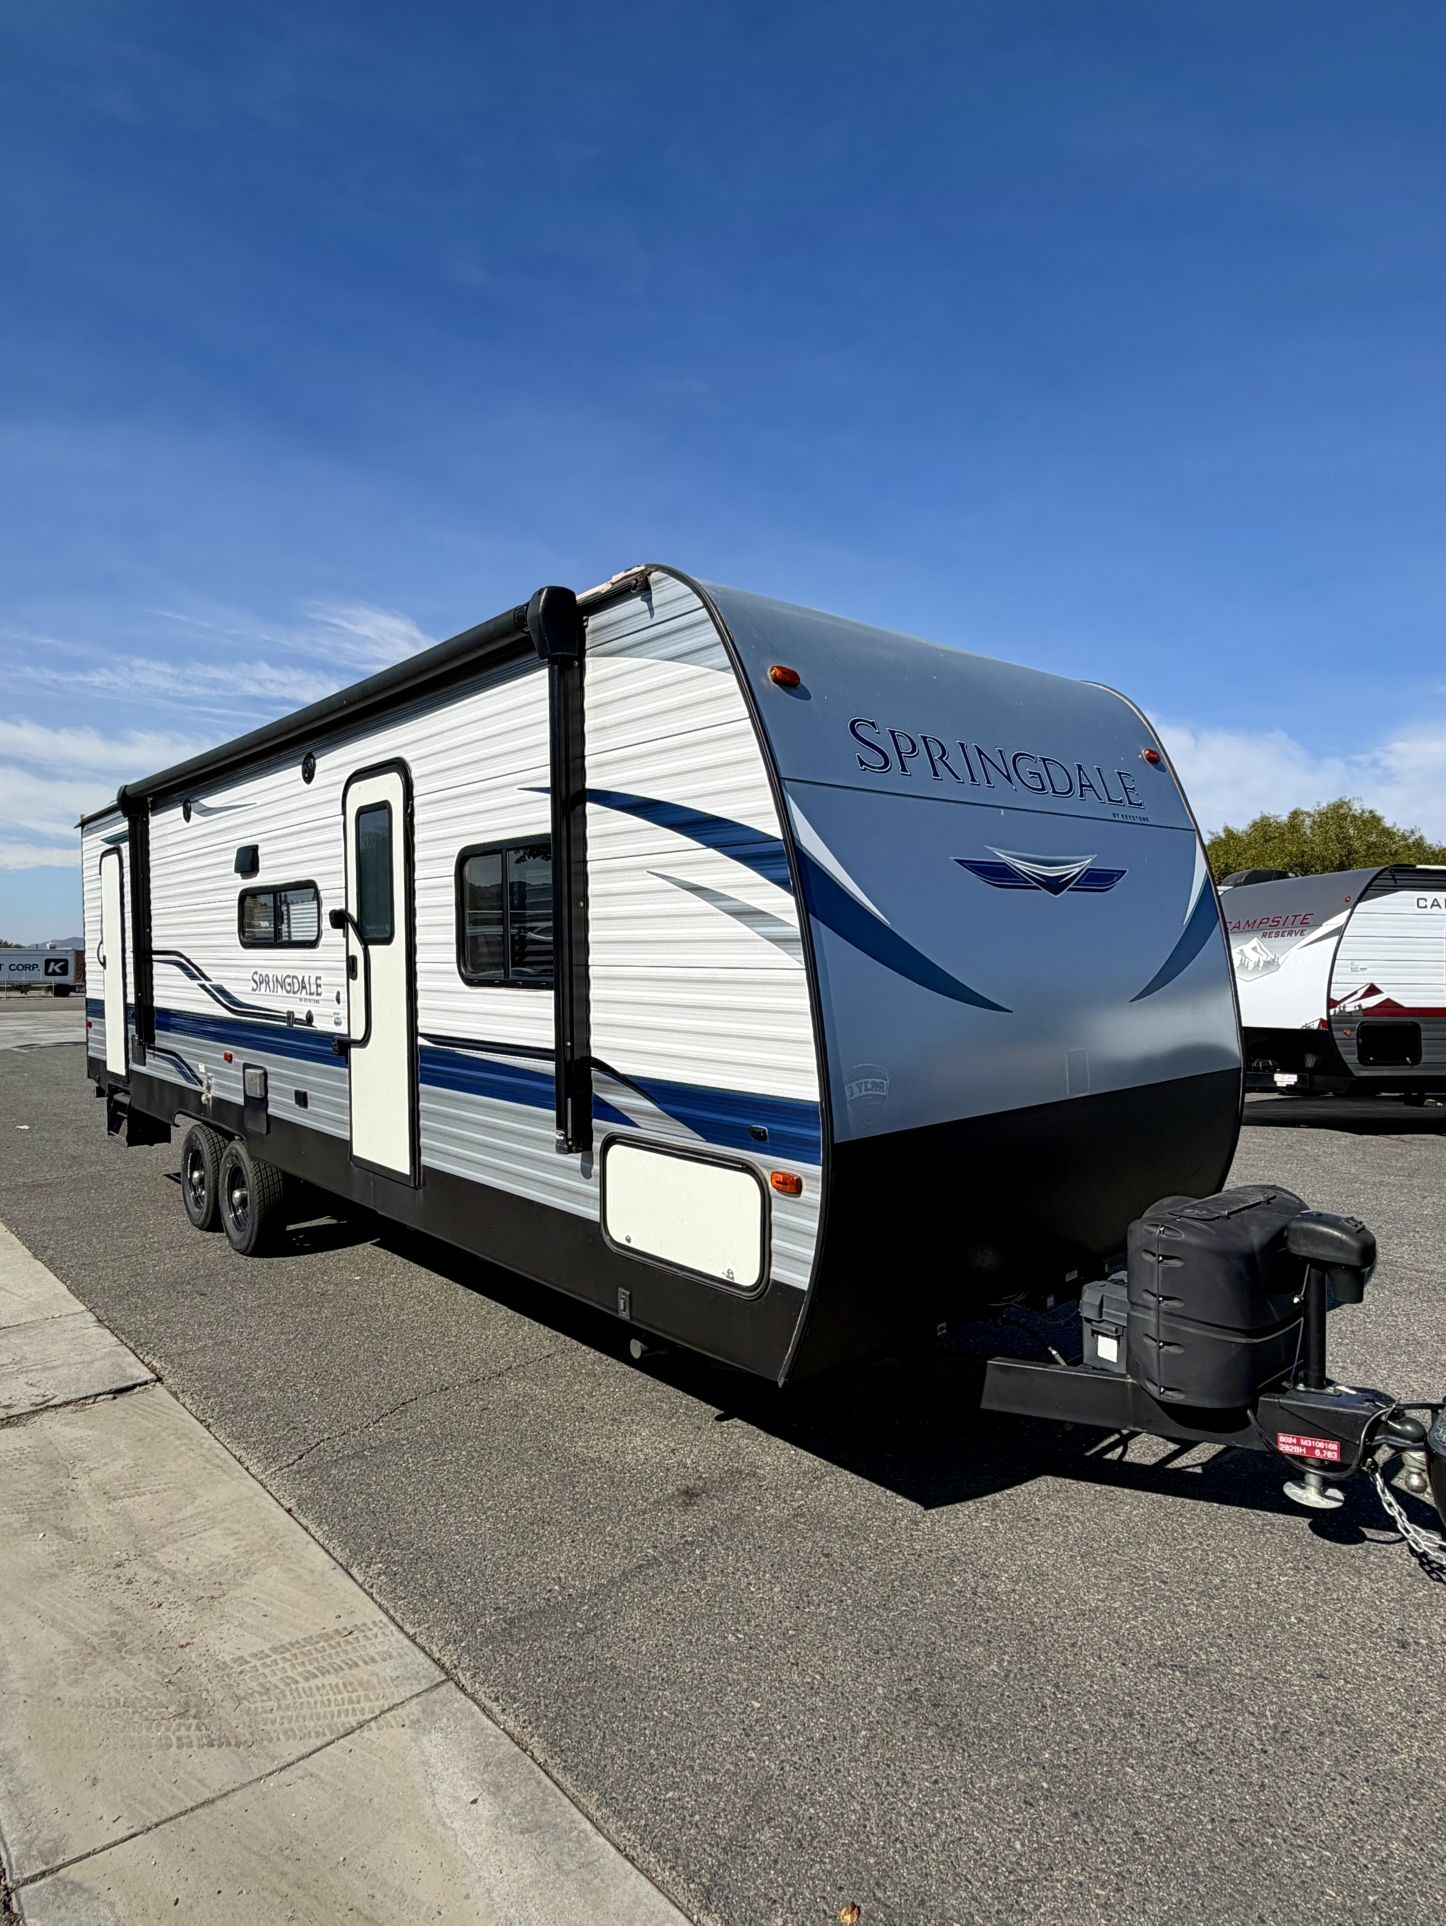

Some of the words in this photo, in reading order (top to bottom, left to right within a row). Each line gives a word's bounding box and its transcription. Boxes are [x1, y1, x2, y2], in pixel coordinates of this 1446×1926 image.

[1417, 897, 1446, 910] CA
[1261, 928, 1308, 940] RESERVE
[8, 963, 41, 972] CORP.
